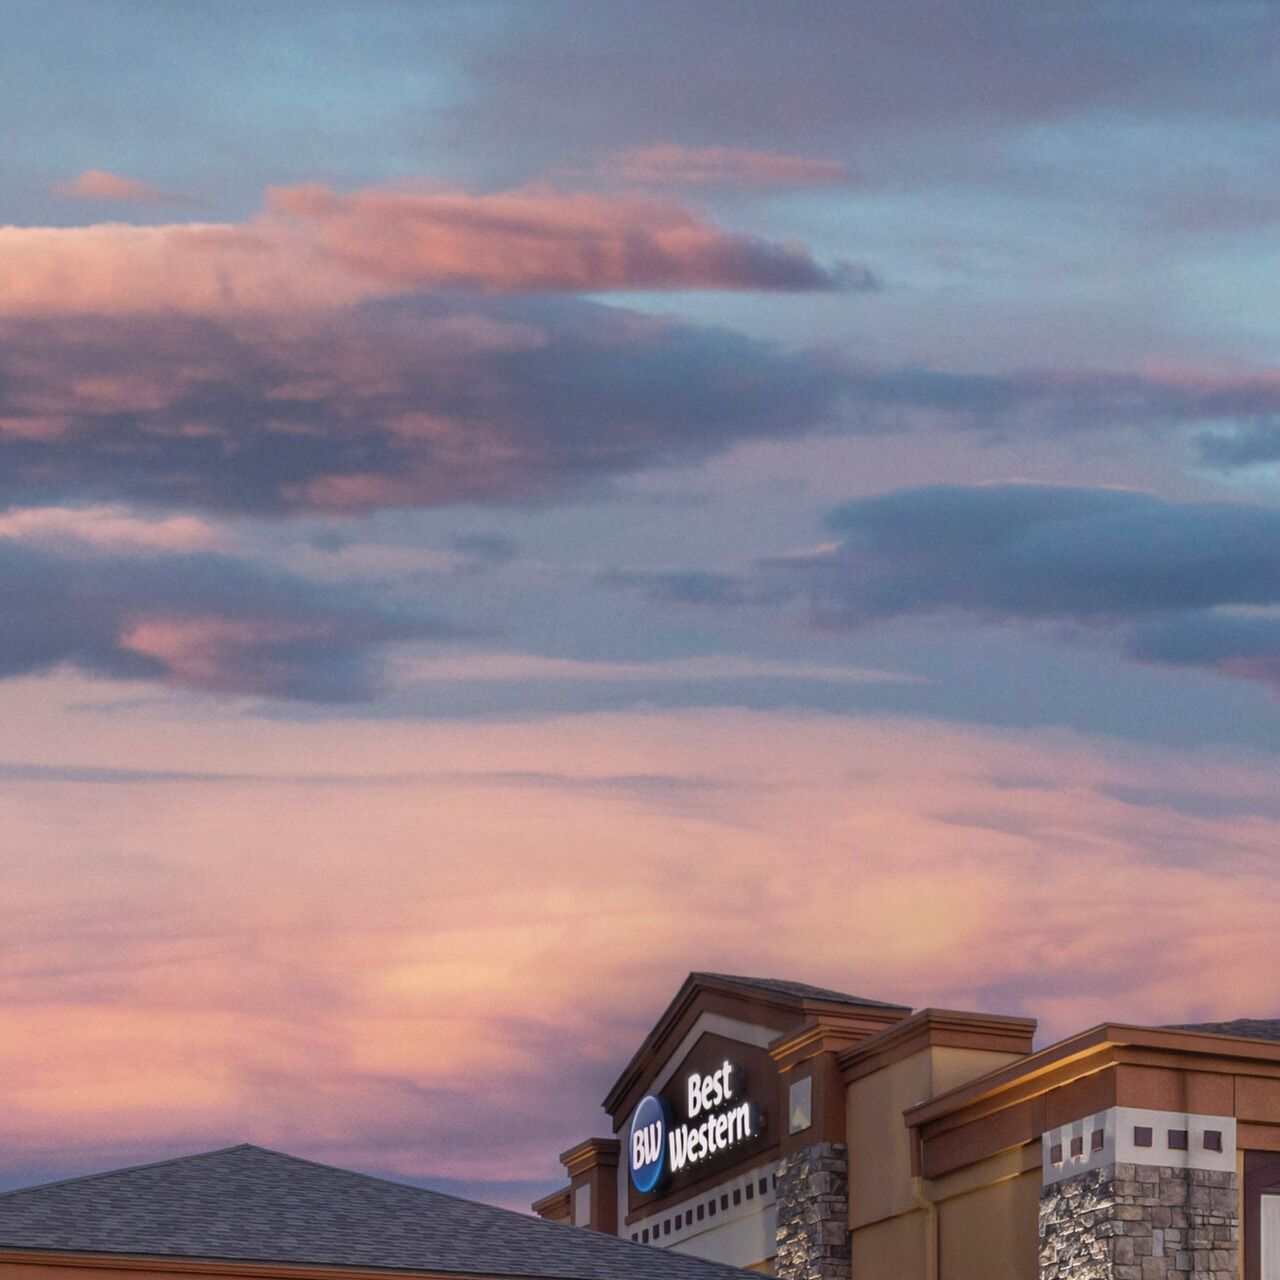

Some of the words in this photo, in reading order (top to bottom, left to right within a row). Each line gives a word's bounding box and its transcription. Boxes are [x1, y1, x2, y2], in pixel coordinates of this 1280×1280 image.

[687, 1060, 732, 1118] Best
[633, 1120, 663, 1170] BW
[668, 1102, 751, 1172] Western
